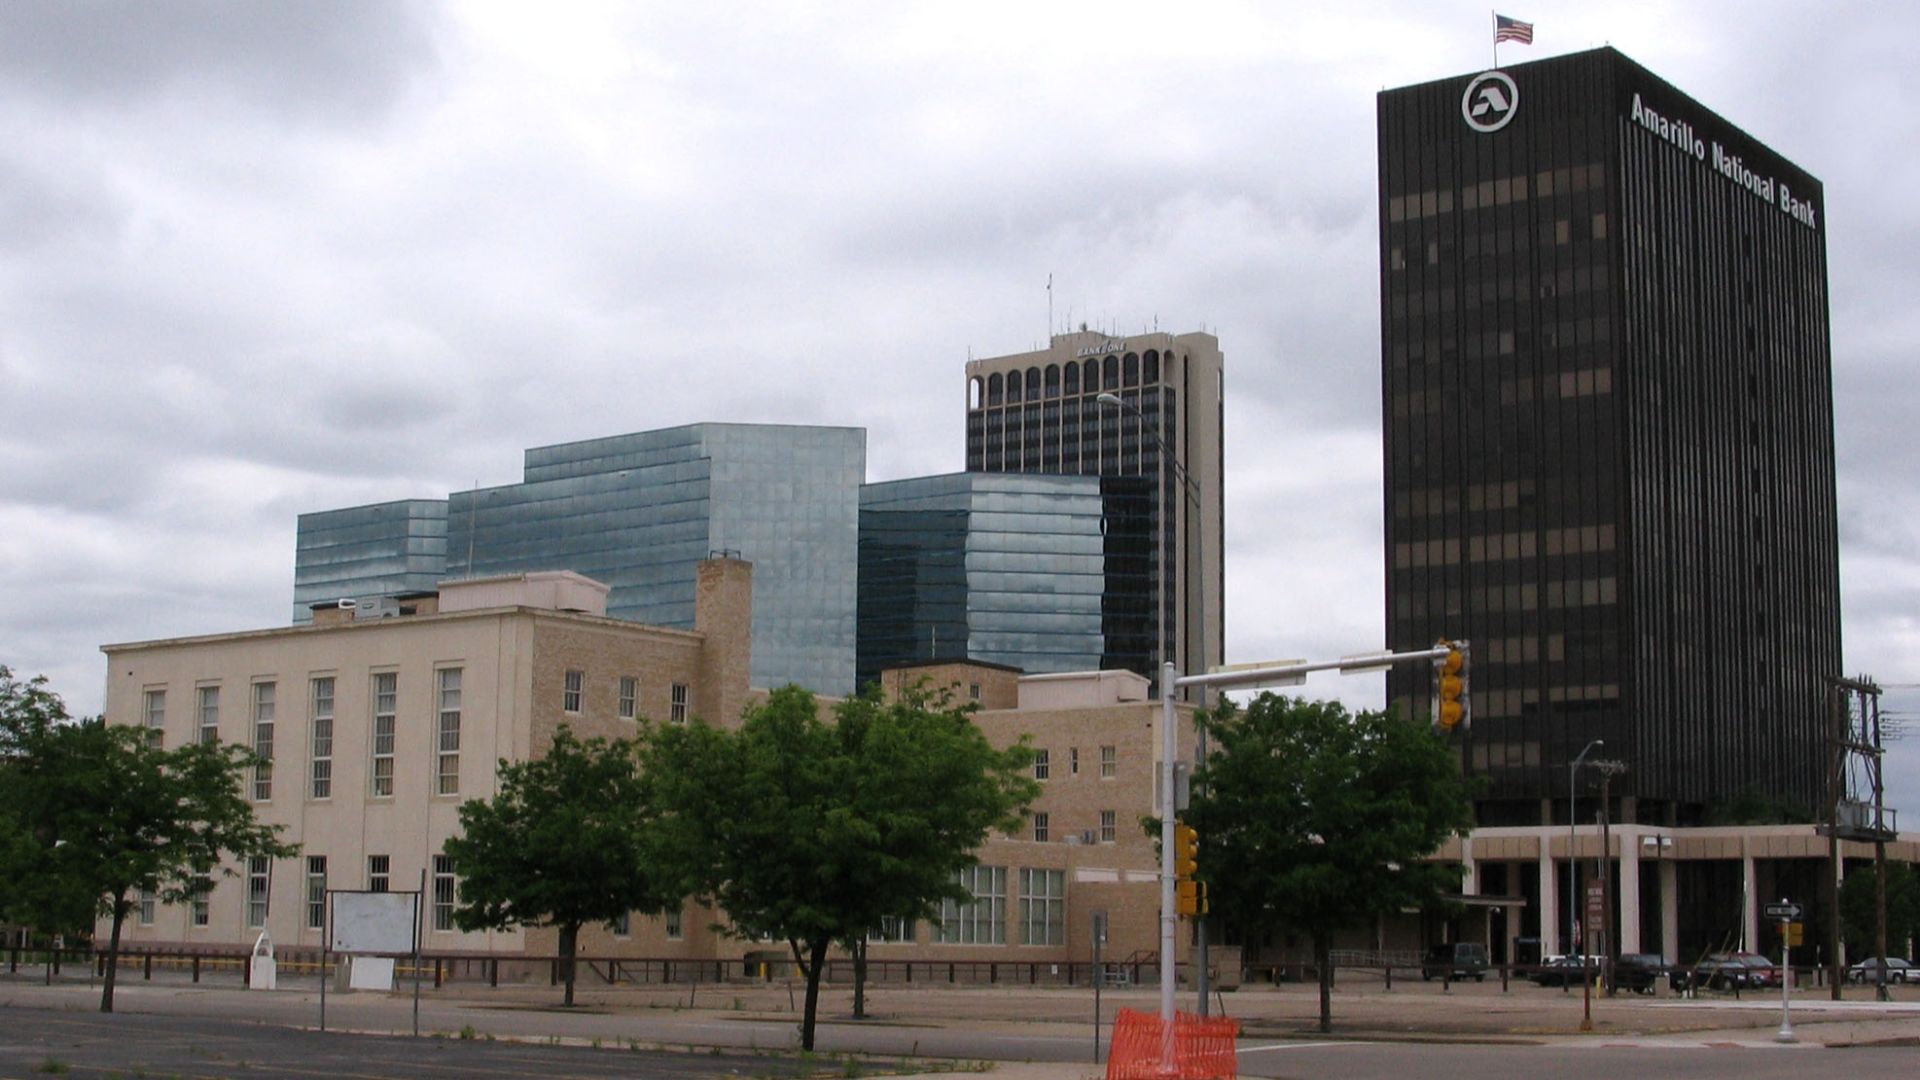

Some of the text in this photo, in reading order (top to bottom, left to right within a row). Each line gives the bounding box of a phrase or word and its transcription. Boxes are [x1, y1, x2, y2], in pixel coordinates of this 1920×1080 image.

[1631, 93, 1816, 230] Amarillo National Bank
